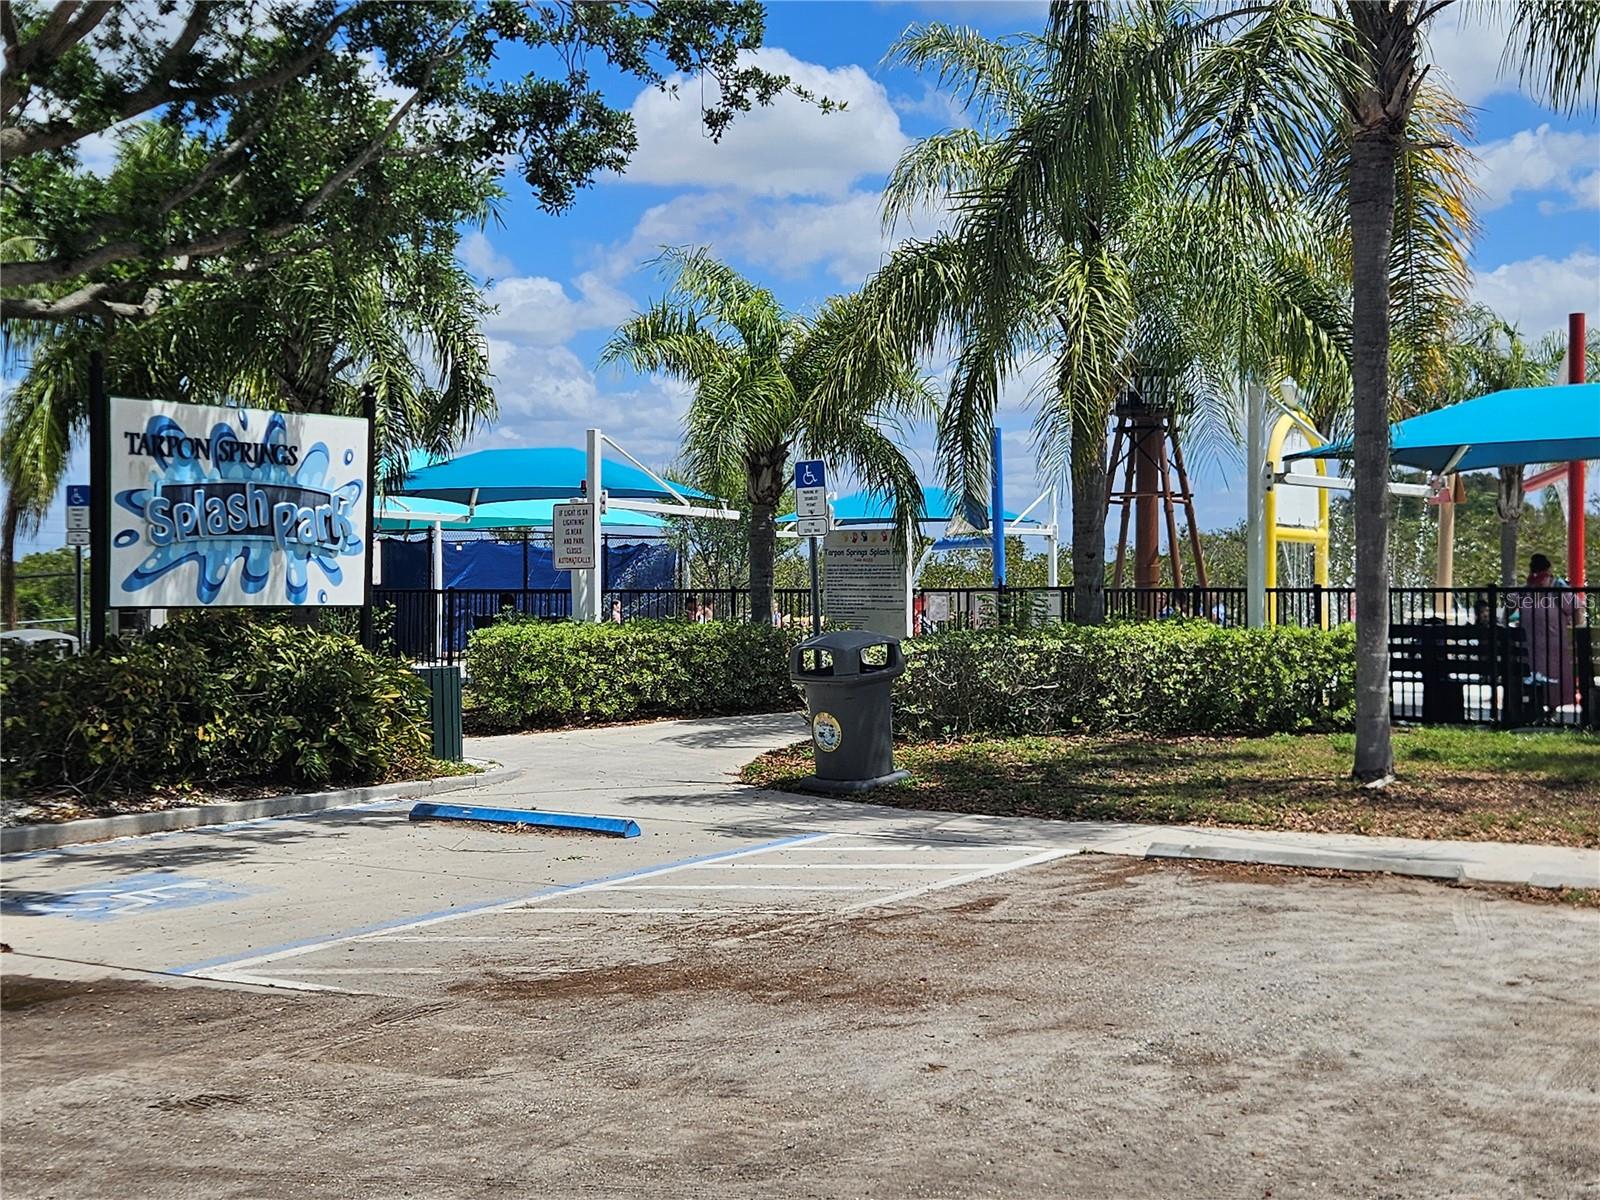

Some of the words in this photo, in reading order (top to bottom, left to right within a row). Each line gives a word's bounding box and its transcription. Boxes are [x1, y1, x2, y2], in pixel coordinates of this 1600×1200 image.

[124, 431, 211, 460] TARPON
[218, 441, 298, 466] SPRINGS
[824, 548, 845, 557] Tarpon
[846, 548, 867, 557] Springs
[869, 548, 890, 557] Splash
